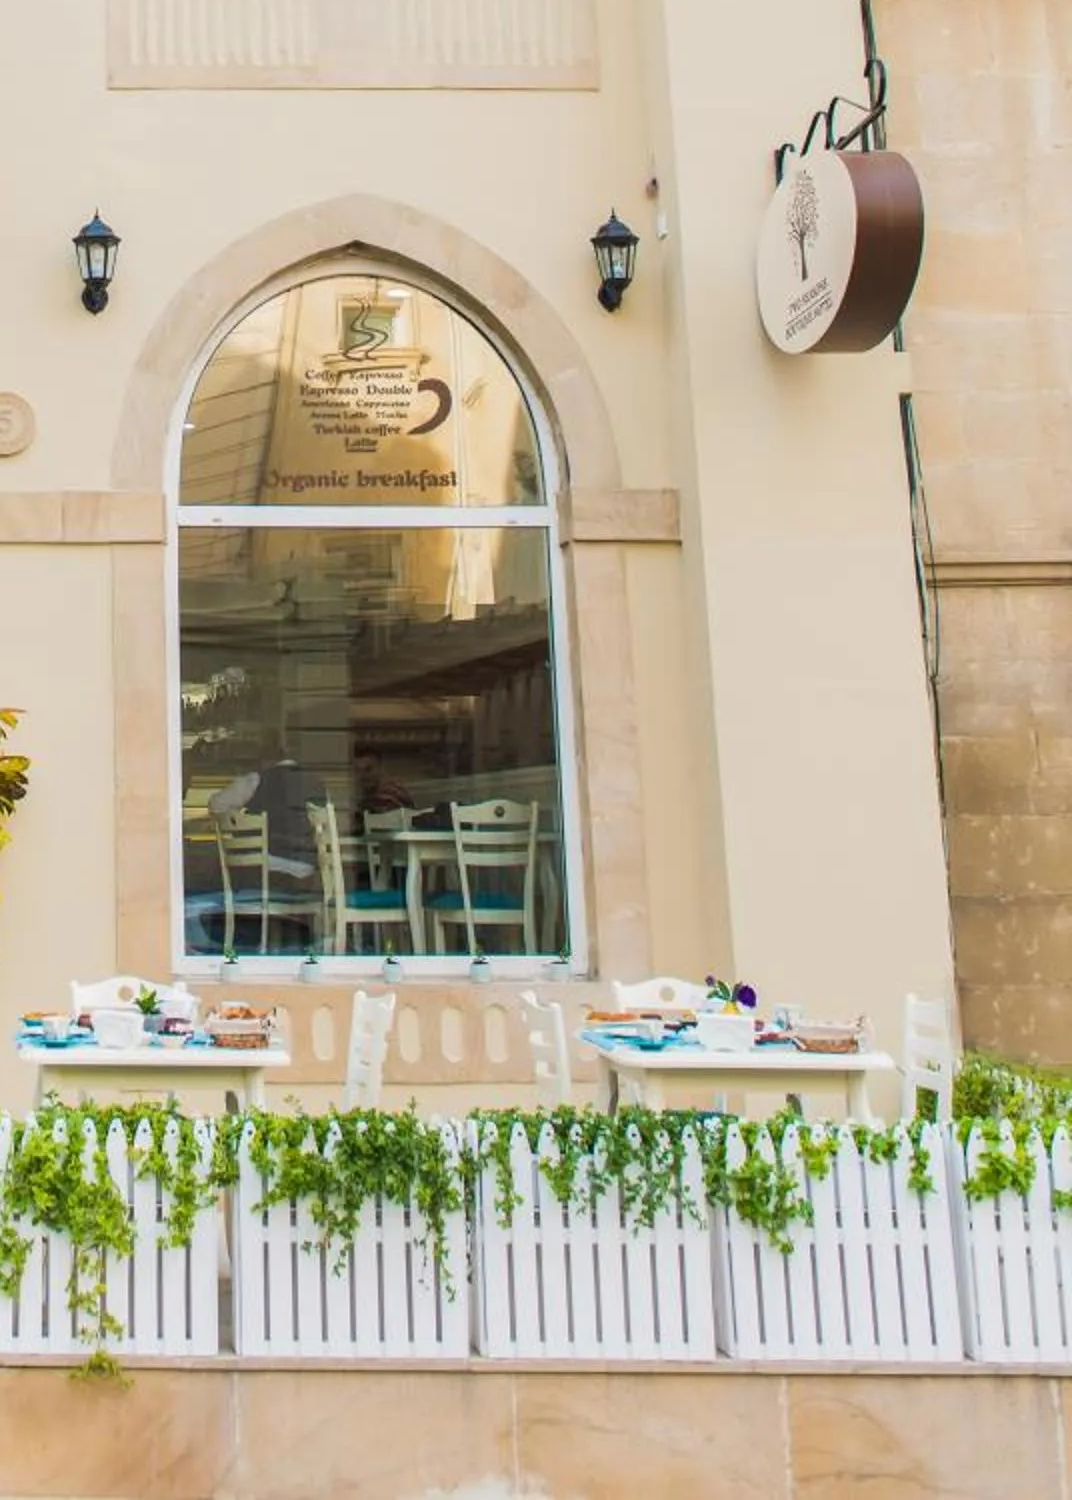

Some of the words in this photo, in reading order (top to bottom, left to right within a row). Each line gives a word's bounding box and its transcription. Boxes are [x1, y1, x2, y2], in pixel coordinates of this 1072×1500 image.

[299, 384, 359, 398] Espresso
[366, 384, 413, 395] Double
[313, 422, 361, 434] Turkish
[364, 423, 401, 436] coffee
[266, 469, 350, 492] Organic
[356, 469, 458, 492] breakfast
